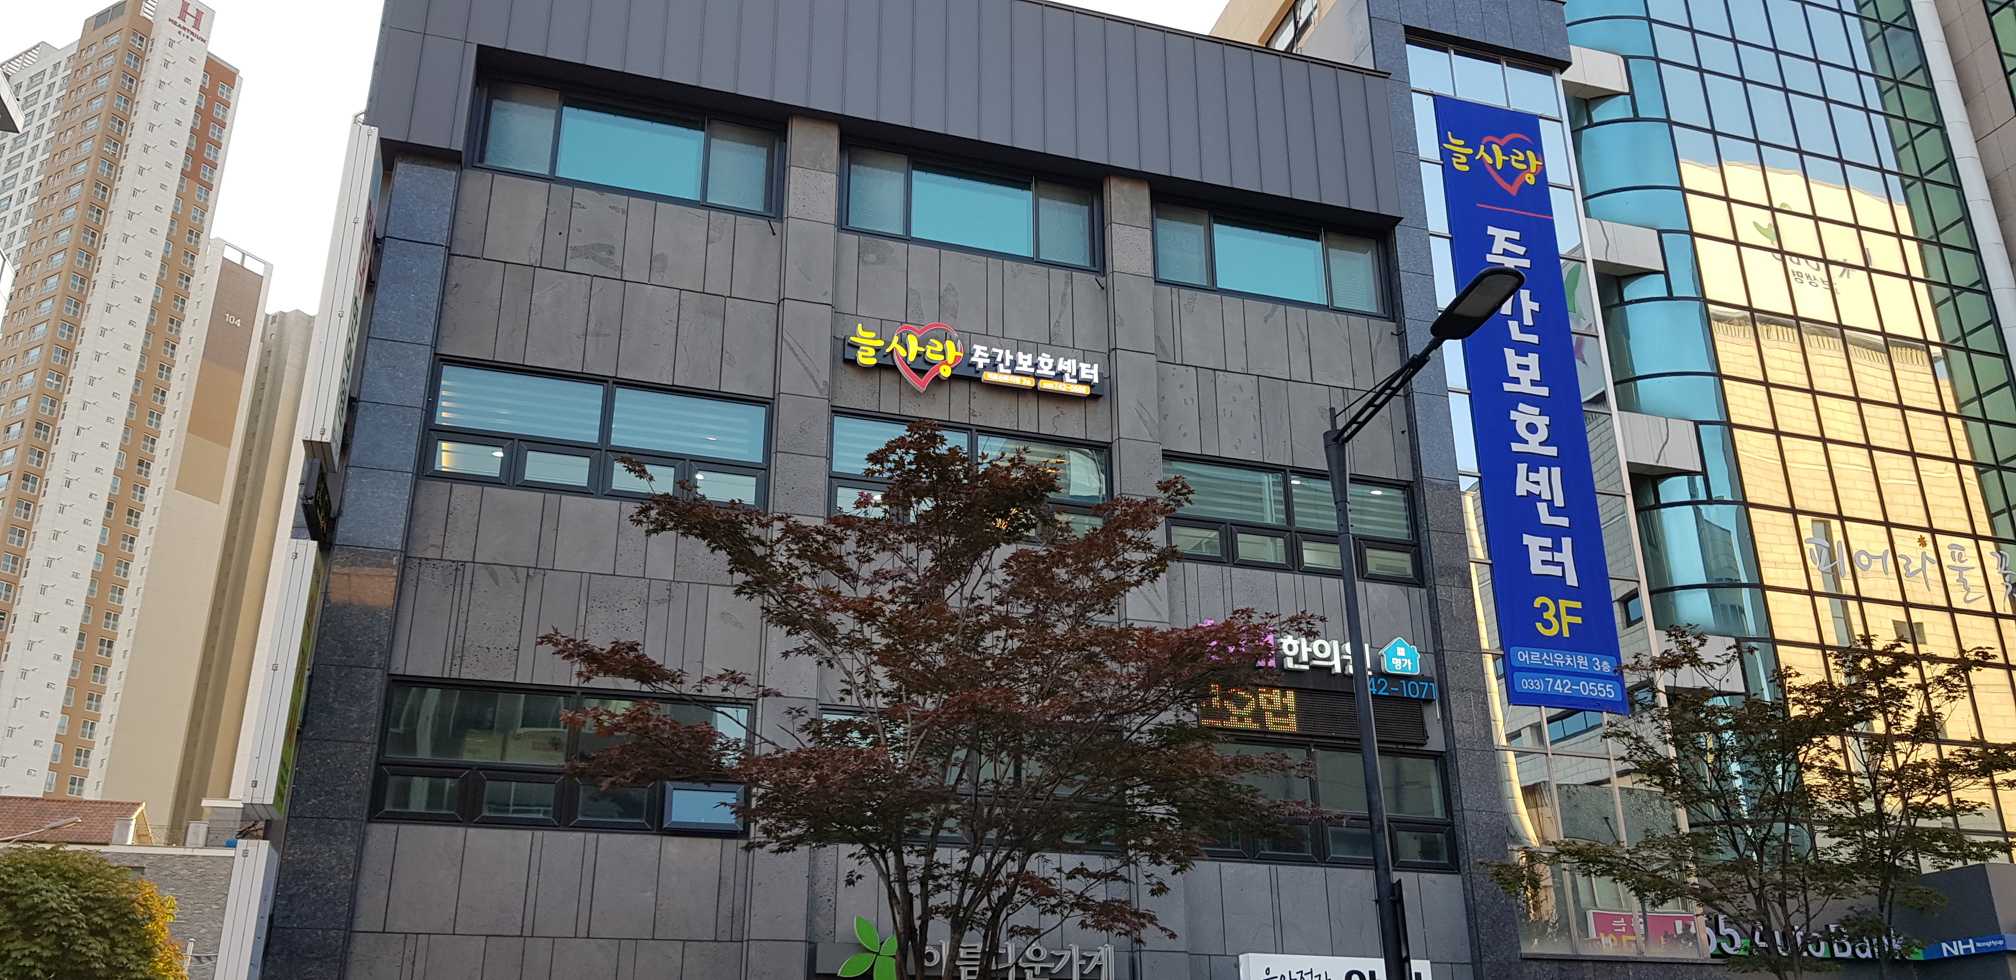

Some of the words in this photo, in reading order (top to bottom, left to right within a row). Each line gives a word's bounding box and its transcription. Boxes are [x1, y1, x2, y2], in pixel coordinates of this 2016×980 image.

[178, 31, 194, 42] CITY
[1443, 131, 1543, 185] 늘사랑
[224, 313, 241, 327] 104
[848, 323, 963, 377] 늘사랑
[970, 344, 1099, 384] 주간보호센터
[1485, 225, 1579, 588] 주간보호센터
[1533, 596, 1583, 638] 3F
[1391, 657, 1413, 671] 명가
[1517, 650, 1589, 670] 어르신유치원
[1592, 657, 1611, 673] 3층
[1941, 938, 1976, 957] NH
